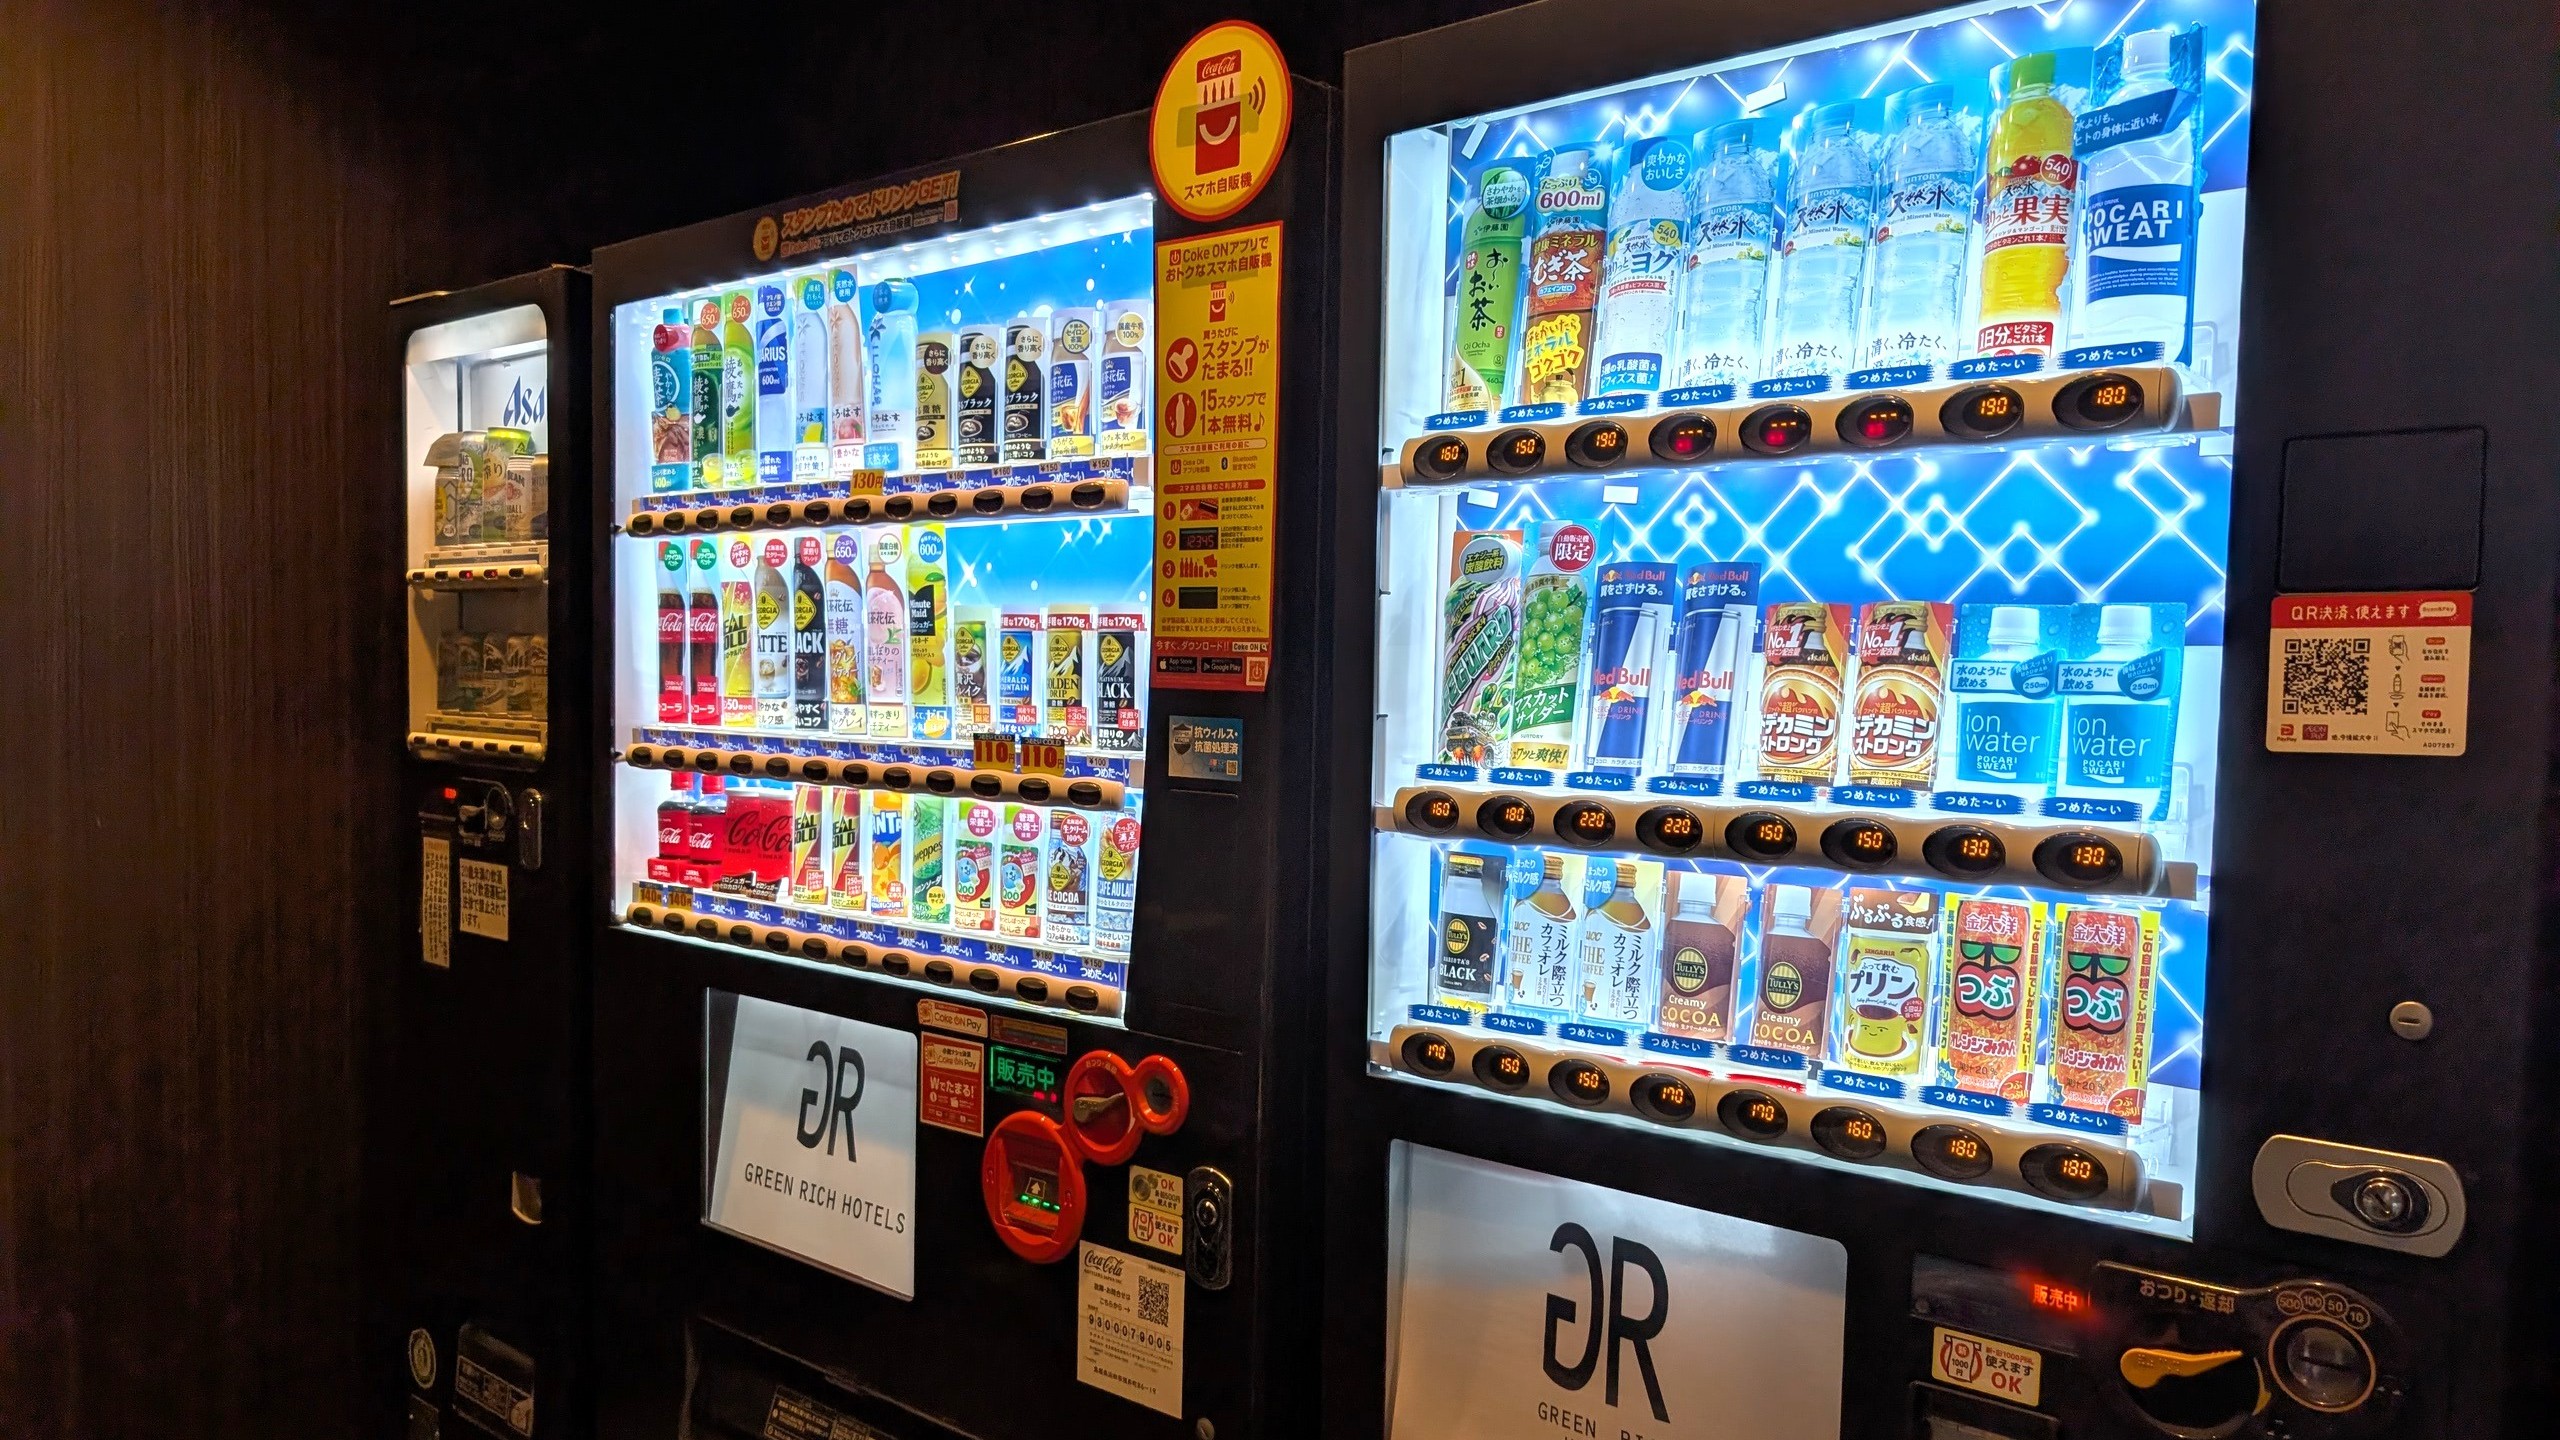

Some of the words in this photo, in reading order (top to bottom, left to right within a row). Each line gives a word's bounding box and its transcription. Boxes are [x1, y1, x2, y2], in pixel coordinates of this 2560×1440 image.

[1648, 153, 1685, 167] 爽やかな
[2045, 159, 2069, 174] 540
[1645, 168, 1685, 181] おいしさ
[1184, 172, 1253, 200] スマホ自販機
[1542, 179, 1577, 188] たっぷり
[1540, 190, 1600, 208] 600ml
[1887, 186, 1955, 218] 天然水
[1793, 201, 1853, 232] 天然水
[2088, 200, 2183, 227] POCARI
[1657, 225, 1676, 237] 540
[1697, 216, 1755, 246] 天然水
[2086, 220, 2172, 248] SWEAT
[1183, 248, 1209, 263] Coke
[1212, 236, 1268, 258] ONアプリで
[1166, 253, 1272, 282] おトクなスマホ自販機
[1533, 250, 1591, 285] むぎ茶
[1469, 271, 1498, 331] お茶
[1203, 327, 1238, 340] 買うたびに
[2014, 325, 2047, 334] ビタミン
[975, 342, 992, 350] さらに
[1202, 337, 1269, 360] スタンプが
[973, 351, 995, 360] 香り高く
[1532, 349, 1579, 378] ゴクゴク
[1201, 389, 1266, 412] 15スタンプで
[1980, 397, 2007, 415] 190
[1516, 439, 1535, 454] 150
[1596, 432, 1616, 447] 190
[1441, 446, 1458, 460] 160
[1092, 459, 1109, 468] ¥150
[1558, 534, 1589, 542] 自動販売機
[1555, 543, 1590, 562] 限定
[1465, 556, 1504, 574] 炭酸飲料
[1645, 571, 1665, 580] Bull
[1728, 571, 1748, 582] Bull
[2292, 605, 2410, 621] QR決済、使えます
[1807, 654, 1828, 662] Asahi
[1908, 654, 1929, 662] Asahi
[1618, 668, 1650, 686] Bull
[1956, 665, 2007, 676] 水のように
[2062, 666, 2113, 677] 水のように
[1700, 672, 1733, 689] Bull
[1957, 677, 1987, 687] 飲める
[2025, 681, 2048, 690] 250ml
[2062, 679, 2094, 690] 飲める
[2132, 683, 2157, 691] 250ml
[1516, 707, 1565, 729] サイダー
[1966, 708, 2000, 732] ion
[2073, 711, 2107, 735] ion
[1195, 741, 1238, 754] 抗菌処理済
[1966, 732, 2040, 753] water
[2072, 736, 2150, 757] water
[1977, 755, 2017, 763] POCARI
[1977, 762, 2013, 770] SWEAT
[2083, 760, 2125, 768] POCARI
[2083, 767, 2120, 775] SWEAT
[1432, 802, 1450, 816] 160
[1505, 807, 1524, 822] 180
[970, 818, 993, 827] 栄養士
[1015, 821, 1038, 831] 栄養士
[1580, 813, 1604, 828] 220
[1665, 818, 1690, 834] 220
[1760, 825, 1783, 841] 150
[1858, 832, 1882, 848] 150
[1963, 840, 1989, 857] 130
[2076, 848, 2104, 865] 130
[1850, 894, 1933, 931] ぷるぷる食感!
[1966, 914, 2018, 935] 金太洋
[2073, 924, 2126, 945] 金太洋
[1538, 923, 1553, 976] カフェオレ
[1550, 925, 1569, 1007] ミルク際立つ
[1610, 933, 1626, 988] カフェオレ
[1862, 962, 1899, 973] ふって飲む
[1439, 965, 1477, 981] BLACK
[1623, 934, 1643, 1019] ミルク際立つ
[1851, 971, 1915, 1000] プリン
[1959, 974, 2015, 1006] つぶ
[1669, 995, 1707, 1009] Creamy
[2067, 986, 2123, 1022] つぶ
[1662, 1006, 1720, 1027] COCOA
[1762, 1011, 1800, 1026] Creamy
[967, 1019, 981, 1032] Pay
[1428, 1044, 1445, 1060] 170
[1950, 1032, 2015, 1056] オレンジみかん
[1501, 1058, 1519, 1074] 150
[2058, 1047, 2125, 1072] オレンジみかん
[997, 1057, 1054, 1091] 販売中
[1578, 1072, 1598, 1088] 150
[930, 1076, 974, 1098] Wでたまる!
[1663, 1087, 1684, 1104] 170
[2115, 1096, 2132, 1107] つぶ
[1752, 1104, 1774, 1121] 170
[1848, 1121, 1871, 1139] 160
[1951, 1140, 1977, 1158] 180
[2064, 1160, 2090, 1179] 180
[1160, 1179, 1175, 1191] OK
[745, 1163, 793, 1196] GREEN
[800, 1181, 835, 1210] RICH
[842, 1196, 905, 1234] HOTELS
[1154, 1221, 1178, 1235] 使えます
[1158, 1234, 1174, 1247] OK
[1099, 1298, 1122, 1311] こちらから
[2034, 1284, 2078, 1312] 販売中
[2140, 1279, 2235, 1314] おつり・返却
[2279, 1298, 2300, 1309] 500
[1952, 1359, 1968, 1369] 1000
[1985, 1355, 2033, 1376] 使えます
[1991, 1372, 2022, 1394] OK
[1538, 1402, 1596, 1438] GREEN
